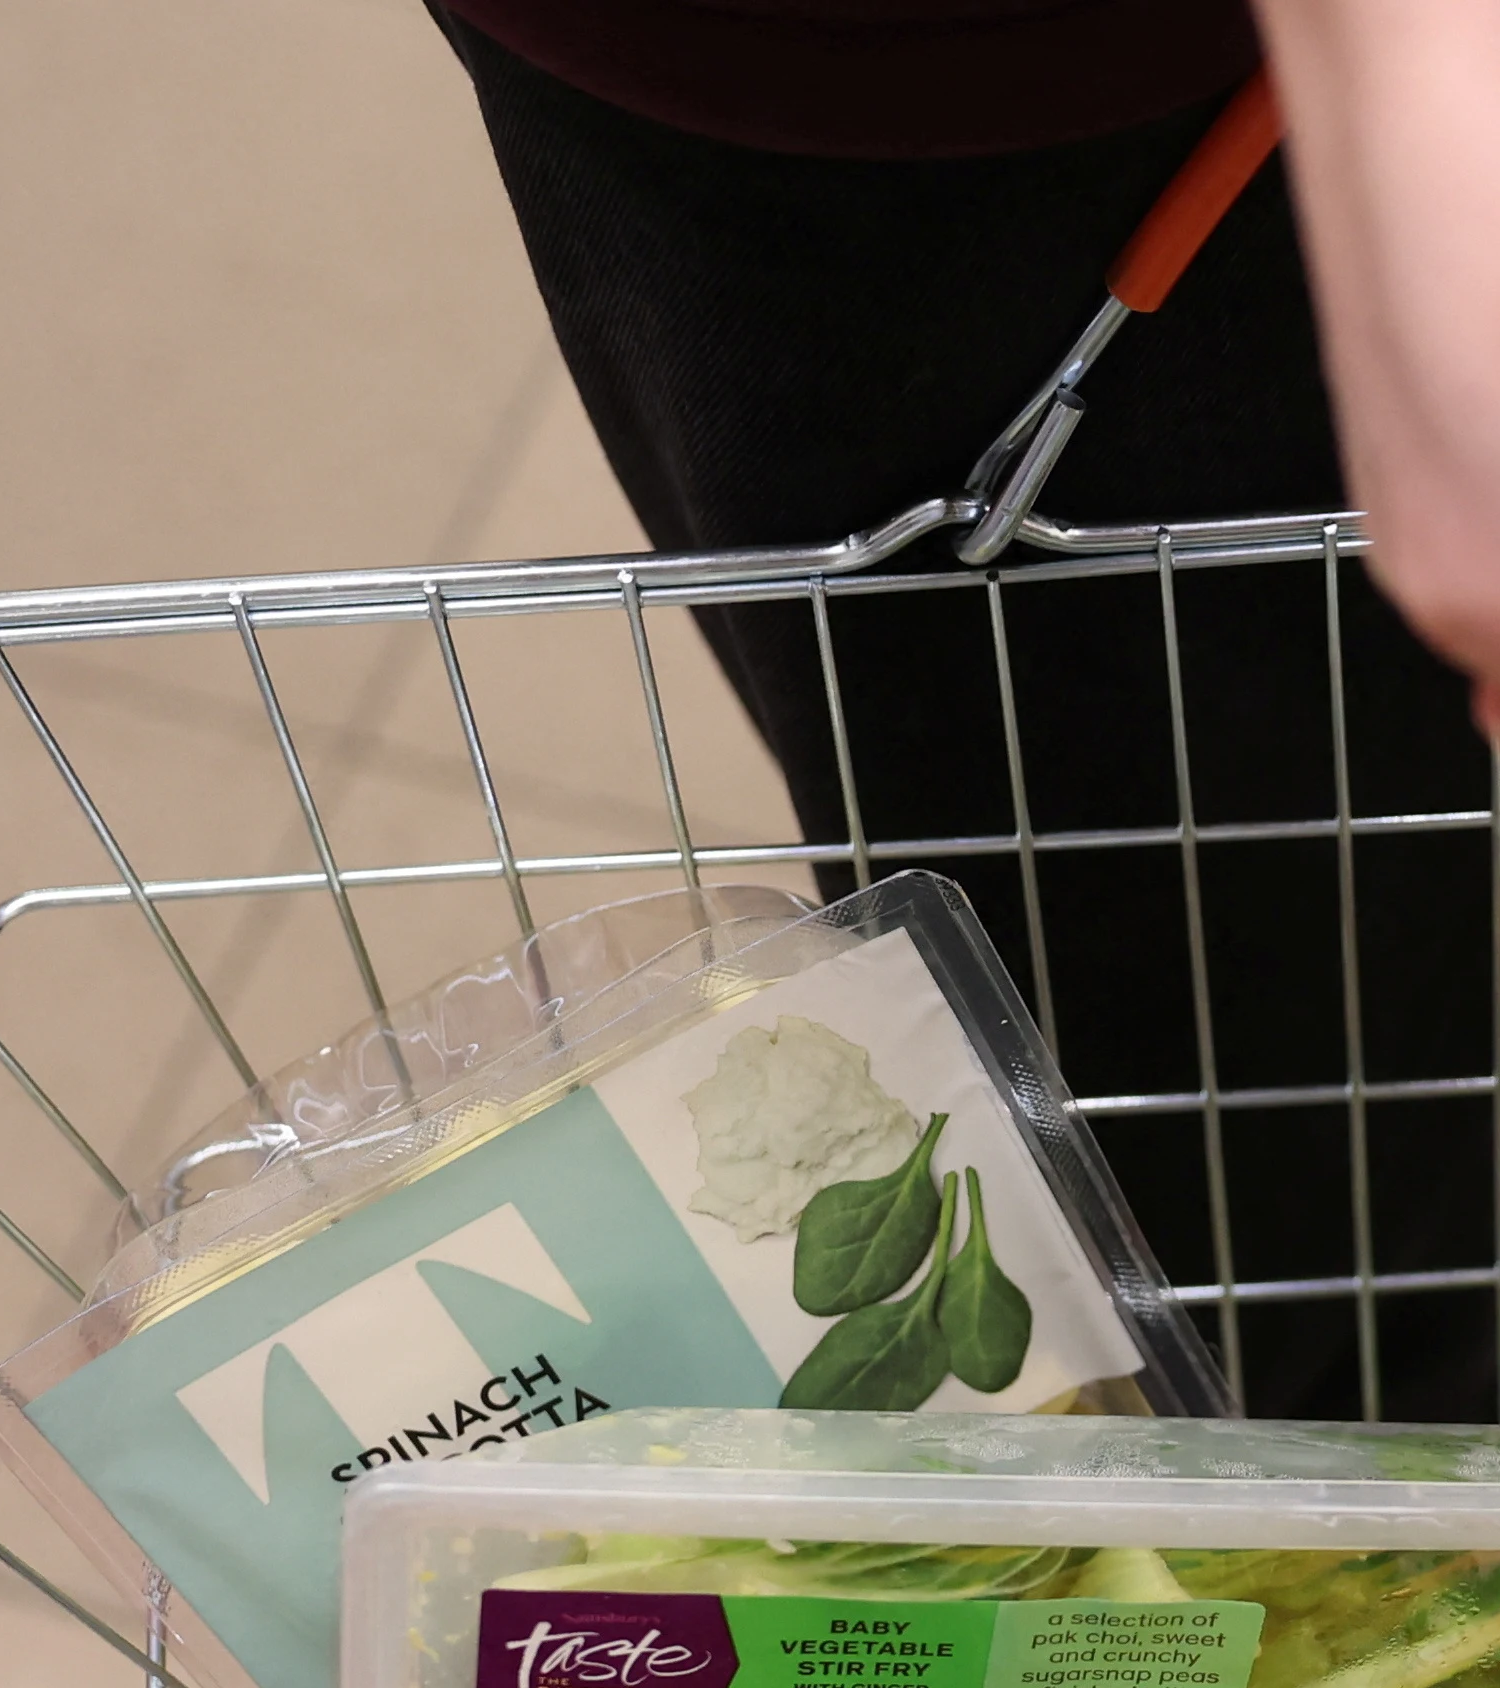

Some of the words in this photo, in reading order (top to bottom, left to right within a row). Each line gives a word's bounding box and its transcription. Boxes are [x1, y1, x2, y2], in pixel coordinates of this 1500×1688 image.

[331, 1353, 562, 1483] SPINACH
[830, 1620, 911, 1635] BABY
[1048, 1613, 1062, 1626] a
[1070, 1612, 1184, 1628] selection
[1192, 1612, 1220, 1627] of
[1032, 1630, 1077, 1649] pak
[1086, 1630, 1143, 1646] choi,
[1151, 1632, 1226, 1648] sweet
[780, 1640, 954, 1657] VEGETABLE
[1049, 1649, 1096, 1663] and
[1103, 1649, 1201, 1667] crunchy
[797, 1661, 864, 1676] STIR
[874, 1662, 931, 1677] FRY
[1021, 1668, 1152, 1685] sugarsnap
[1159, 1670, 1220, 1685] peas
[538, 1677, 570, 1686] THE
